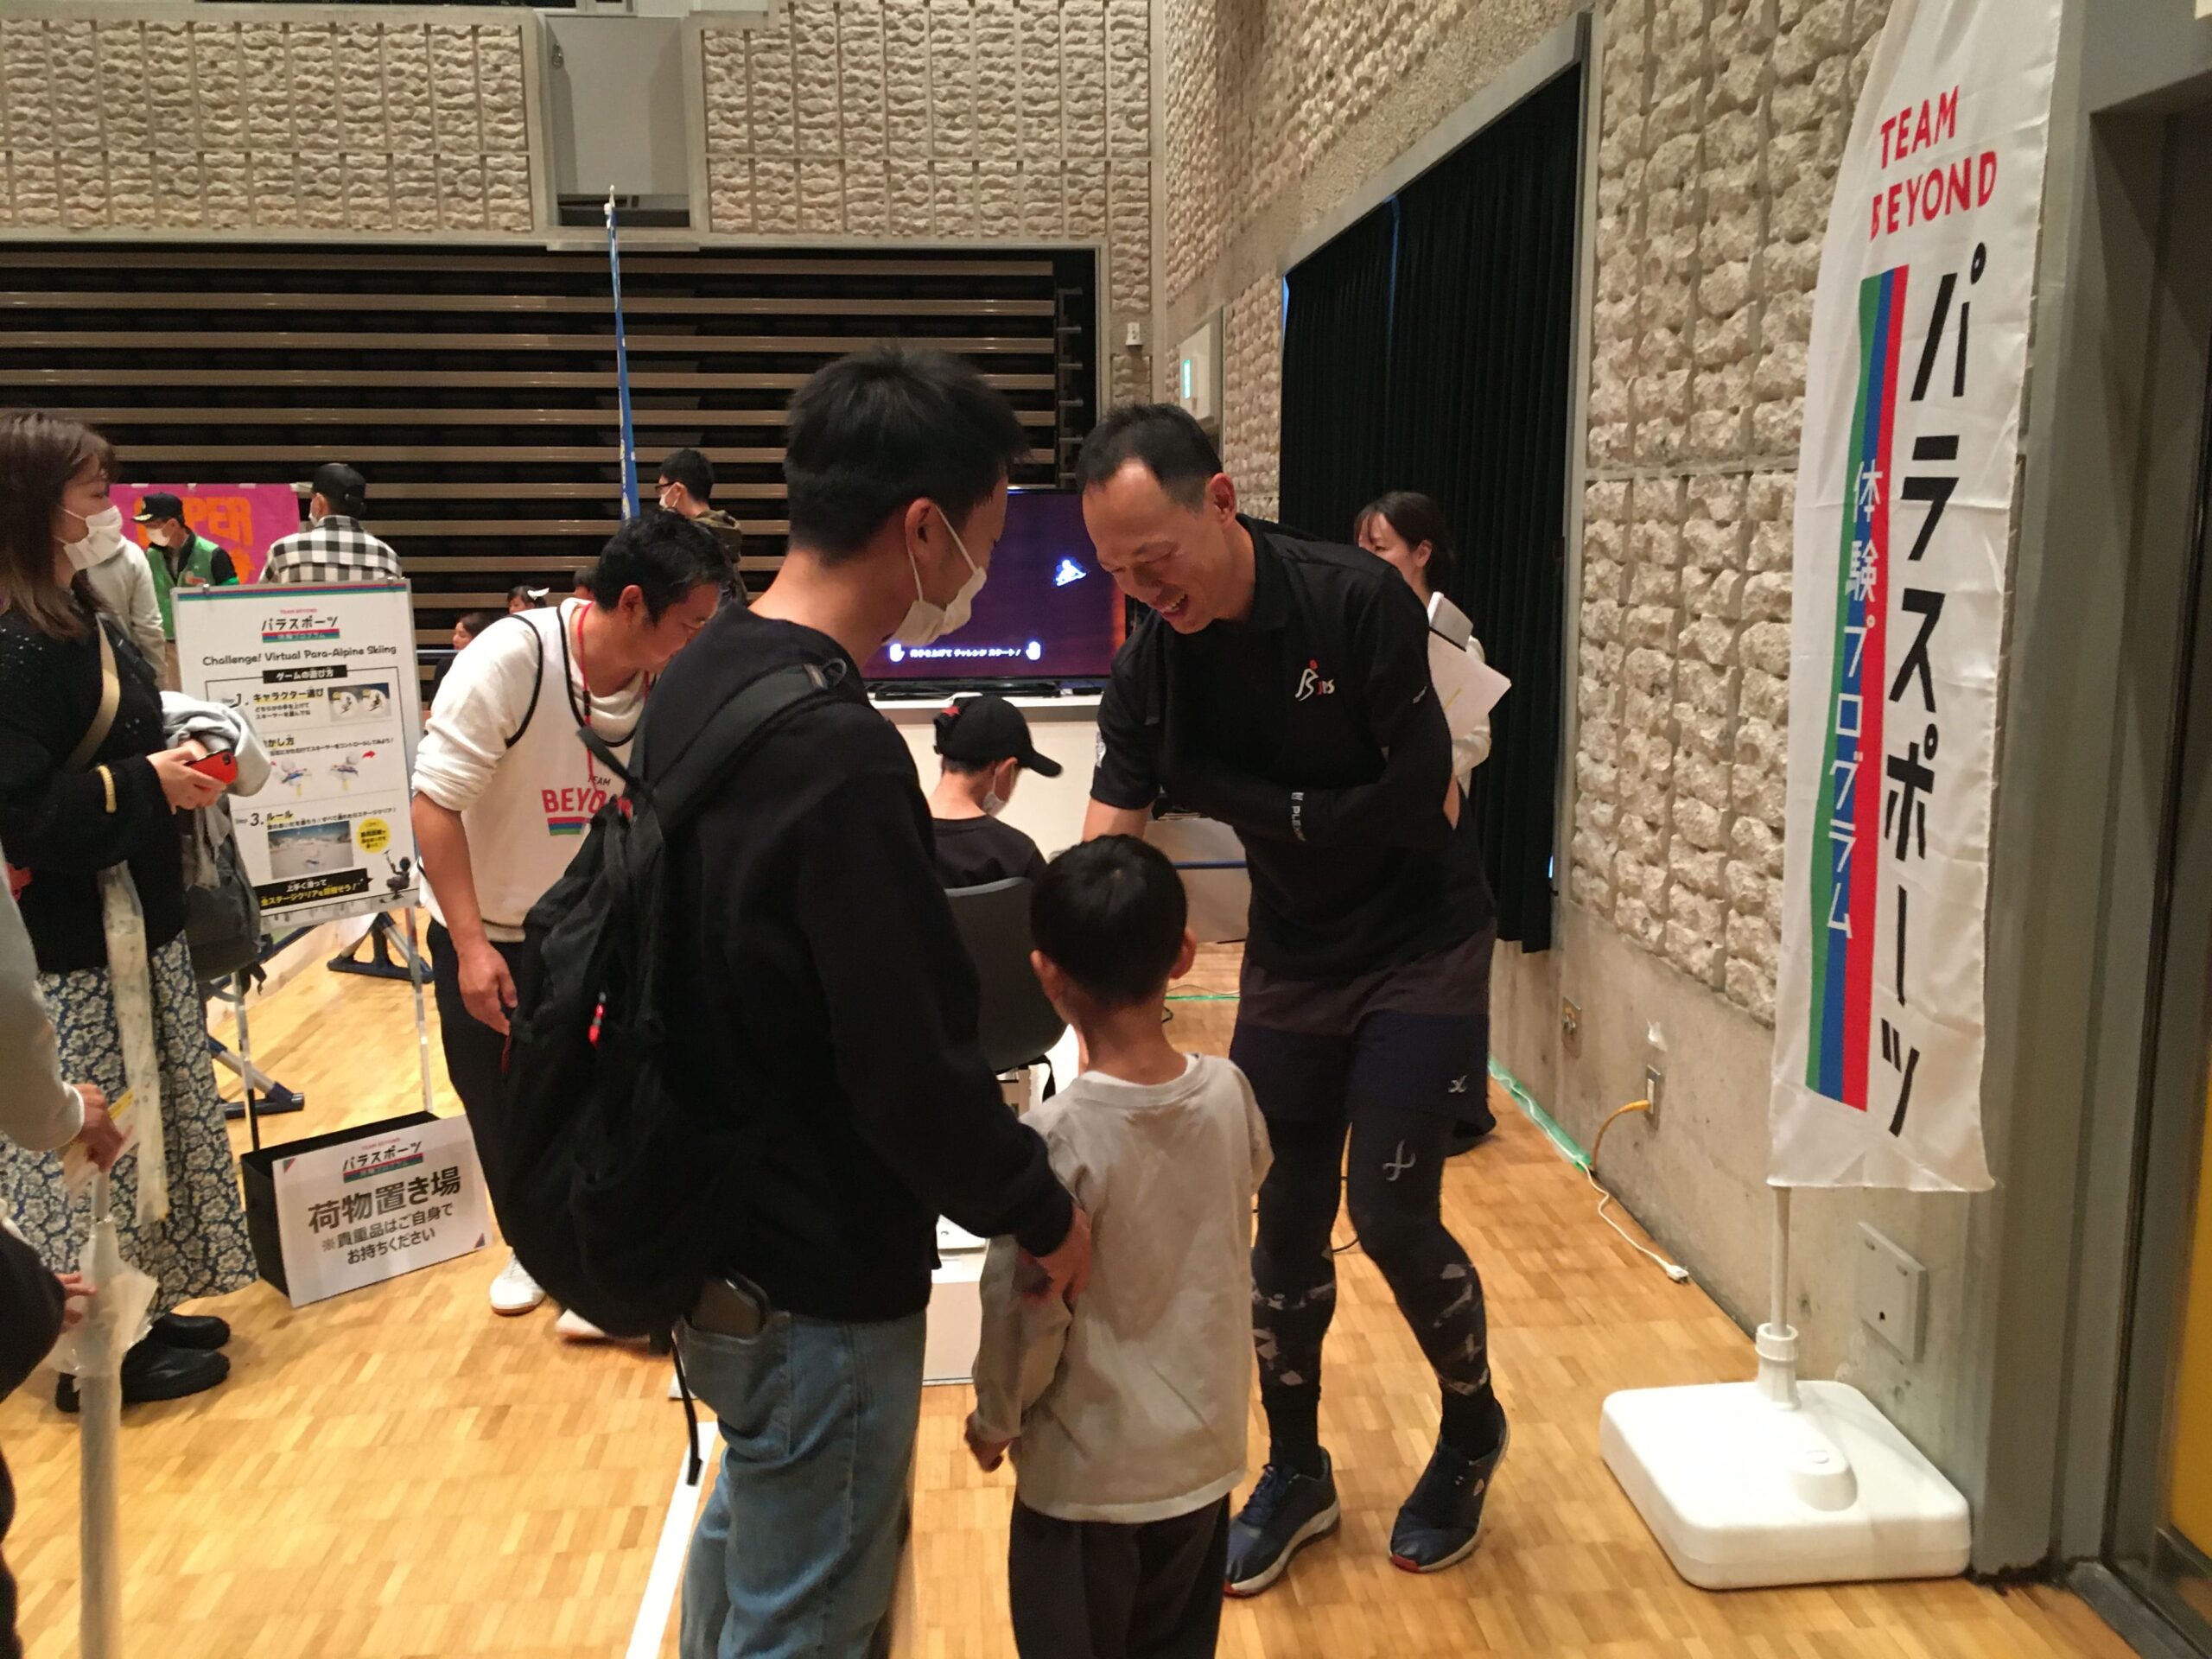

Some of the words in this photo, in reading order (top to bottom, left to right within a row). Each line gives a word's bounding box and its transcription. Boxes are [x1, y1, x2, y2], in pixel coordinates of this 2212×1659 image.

[1880, 85, 1959, 169] TEAM
[1869, 149, 1998, 243] BEYOND
[202, 653, 261, 666] Challenge!
[264, 649, 301, 662] Virtual
[304, 647, 365, 659] Para-Alpine
[367, 644, 397, 655] Skiing
[1827, 459, 1884, 939] 体験プログラム
[1880, 241, 1986, 1138] パラスポーツ
[263, 735, 295, 747] かし方
[267, 810, 294, 821] ルール
[542, 787, 632, 820] BEYO
[308, 1166, 461, 1234] 荷物置き場
[347, 1227, 435, 1265] お持ちください
